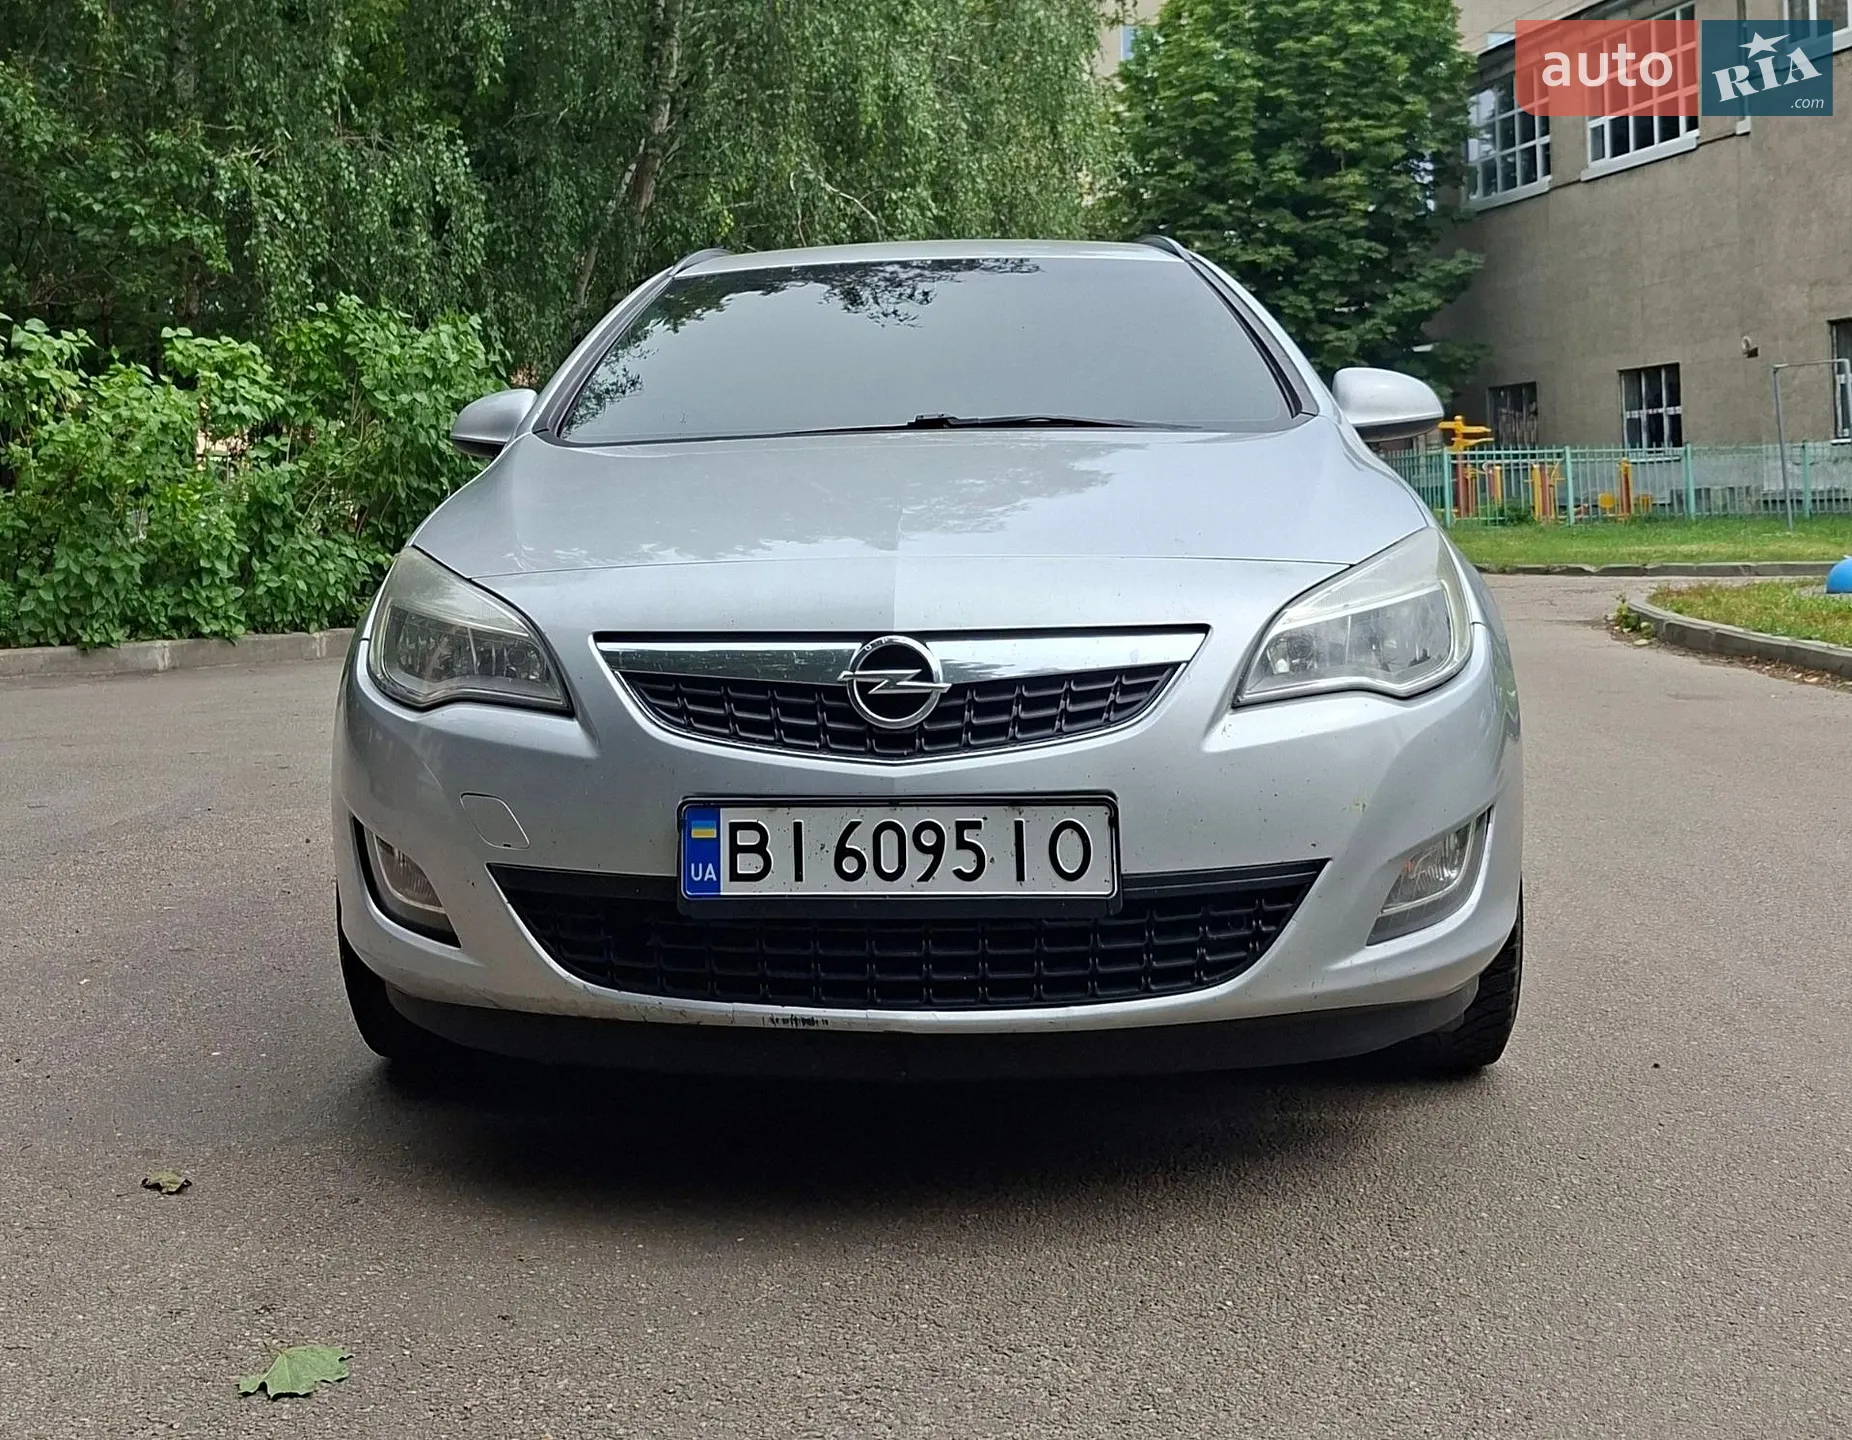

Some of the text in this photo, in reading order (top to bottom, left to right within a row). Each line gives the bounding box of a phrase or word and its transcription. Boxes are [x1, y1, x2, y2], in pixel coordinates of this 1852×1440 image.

[728, 819, 1092, 883] BI 6095 IO
[691, 863, 717, 882] UA
